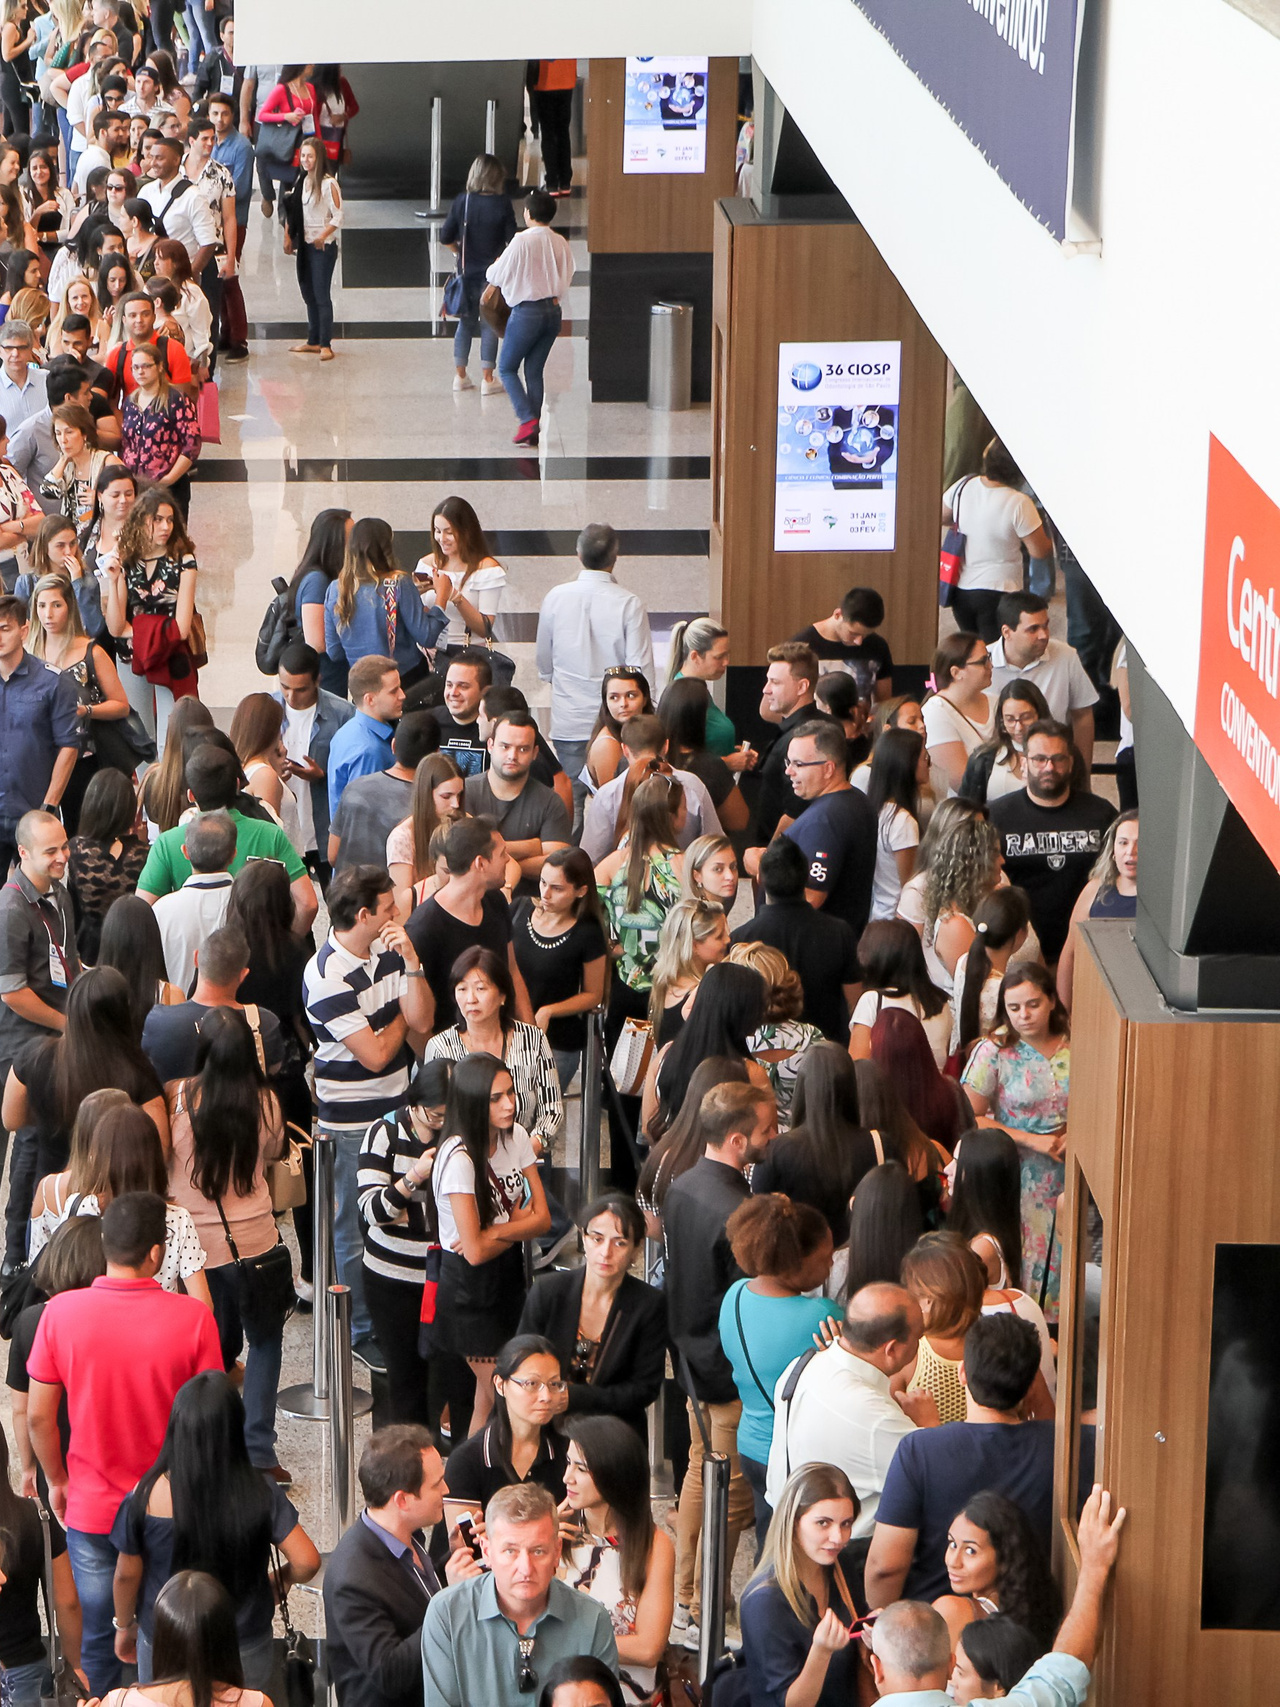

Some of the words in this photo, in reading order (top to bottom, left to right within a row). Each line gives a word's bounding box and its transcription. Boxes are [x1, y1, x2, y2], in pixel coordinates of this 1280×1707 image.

[848, 363, 891, 376] CIOSP
[1005, 829, 1101, 857] RAIDERS
[810, 862, 828, 882] 85
